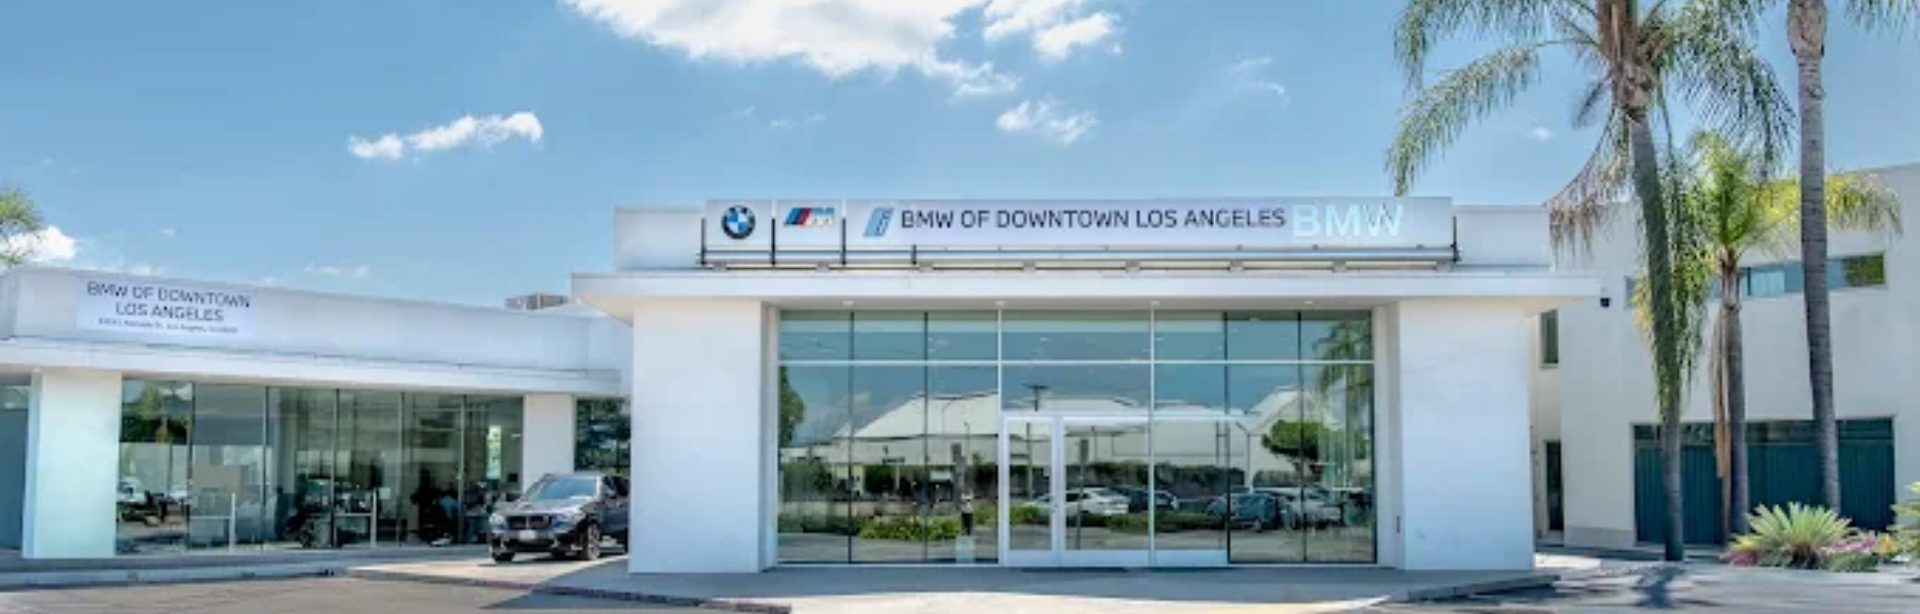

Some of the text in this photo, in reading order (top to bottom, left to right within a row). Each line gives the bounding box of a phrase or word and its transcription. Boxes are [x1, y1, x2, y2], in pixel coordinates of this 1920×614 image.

[901, 208, 1286, 229] BMW OF DOWNTOWN LOS ANGELES
[1291, 203, 1404, 238] BMW
[87, 280, 250, 308] BMW OF DOWNTOWN
[115, 302, 224, 322] LOS ANGELES
